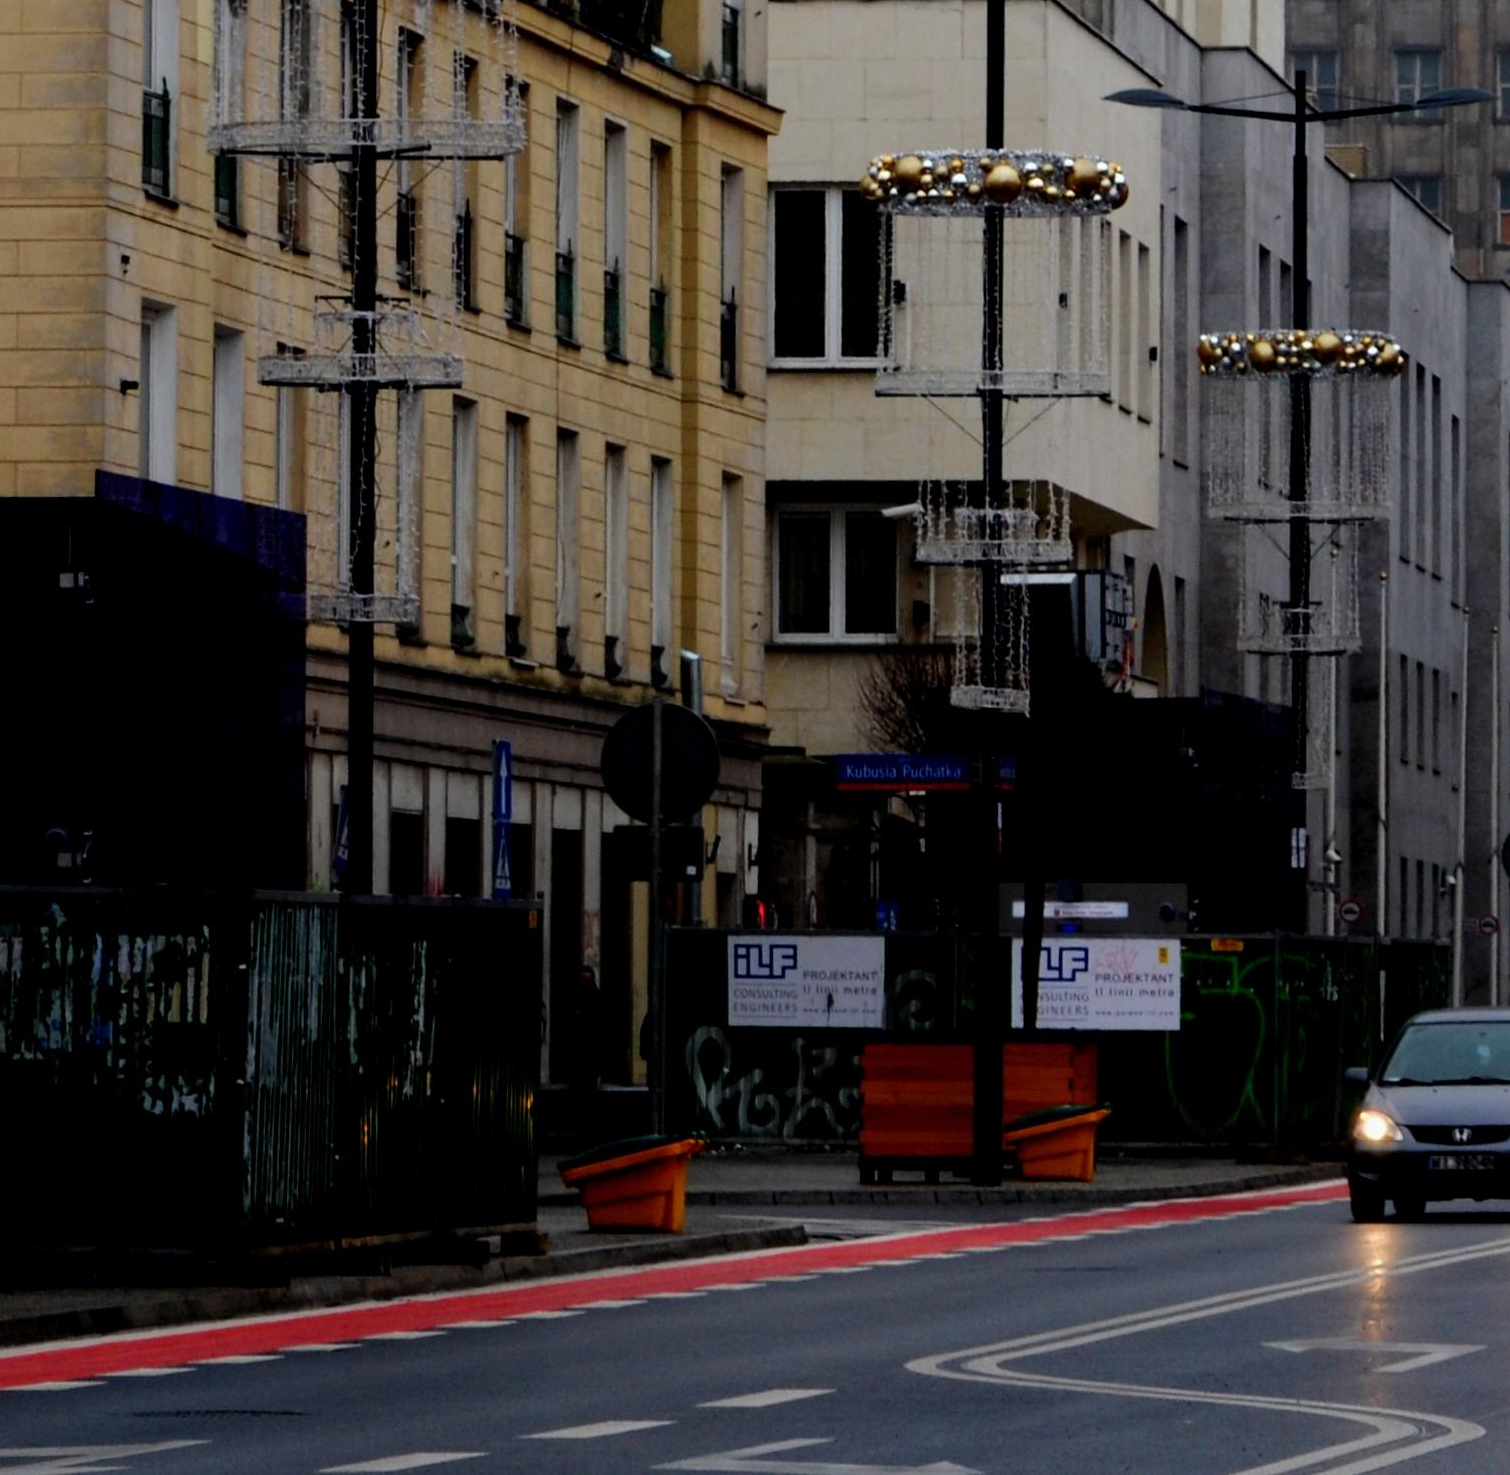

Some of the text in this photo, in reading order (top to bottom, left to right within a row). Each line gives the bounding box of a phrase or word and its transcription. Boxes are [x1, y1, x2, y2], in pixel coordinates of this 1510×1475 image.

[846, 764, 962, 779] Kubusia Puchatka
[1038, 947, 1089, 982] LF
[802, 970, 878, 982] PROJEKTANT
[1094, 973, 1174, 983] PROJEKTANT
[733, 988, 798, 1000] CONSULTING
[843, 986, 877, 995] metra
[1139, 988, 1175, 996] metra
[733, 1002, 798, 1014] ENGINEERS
